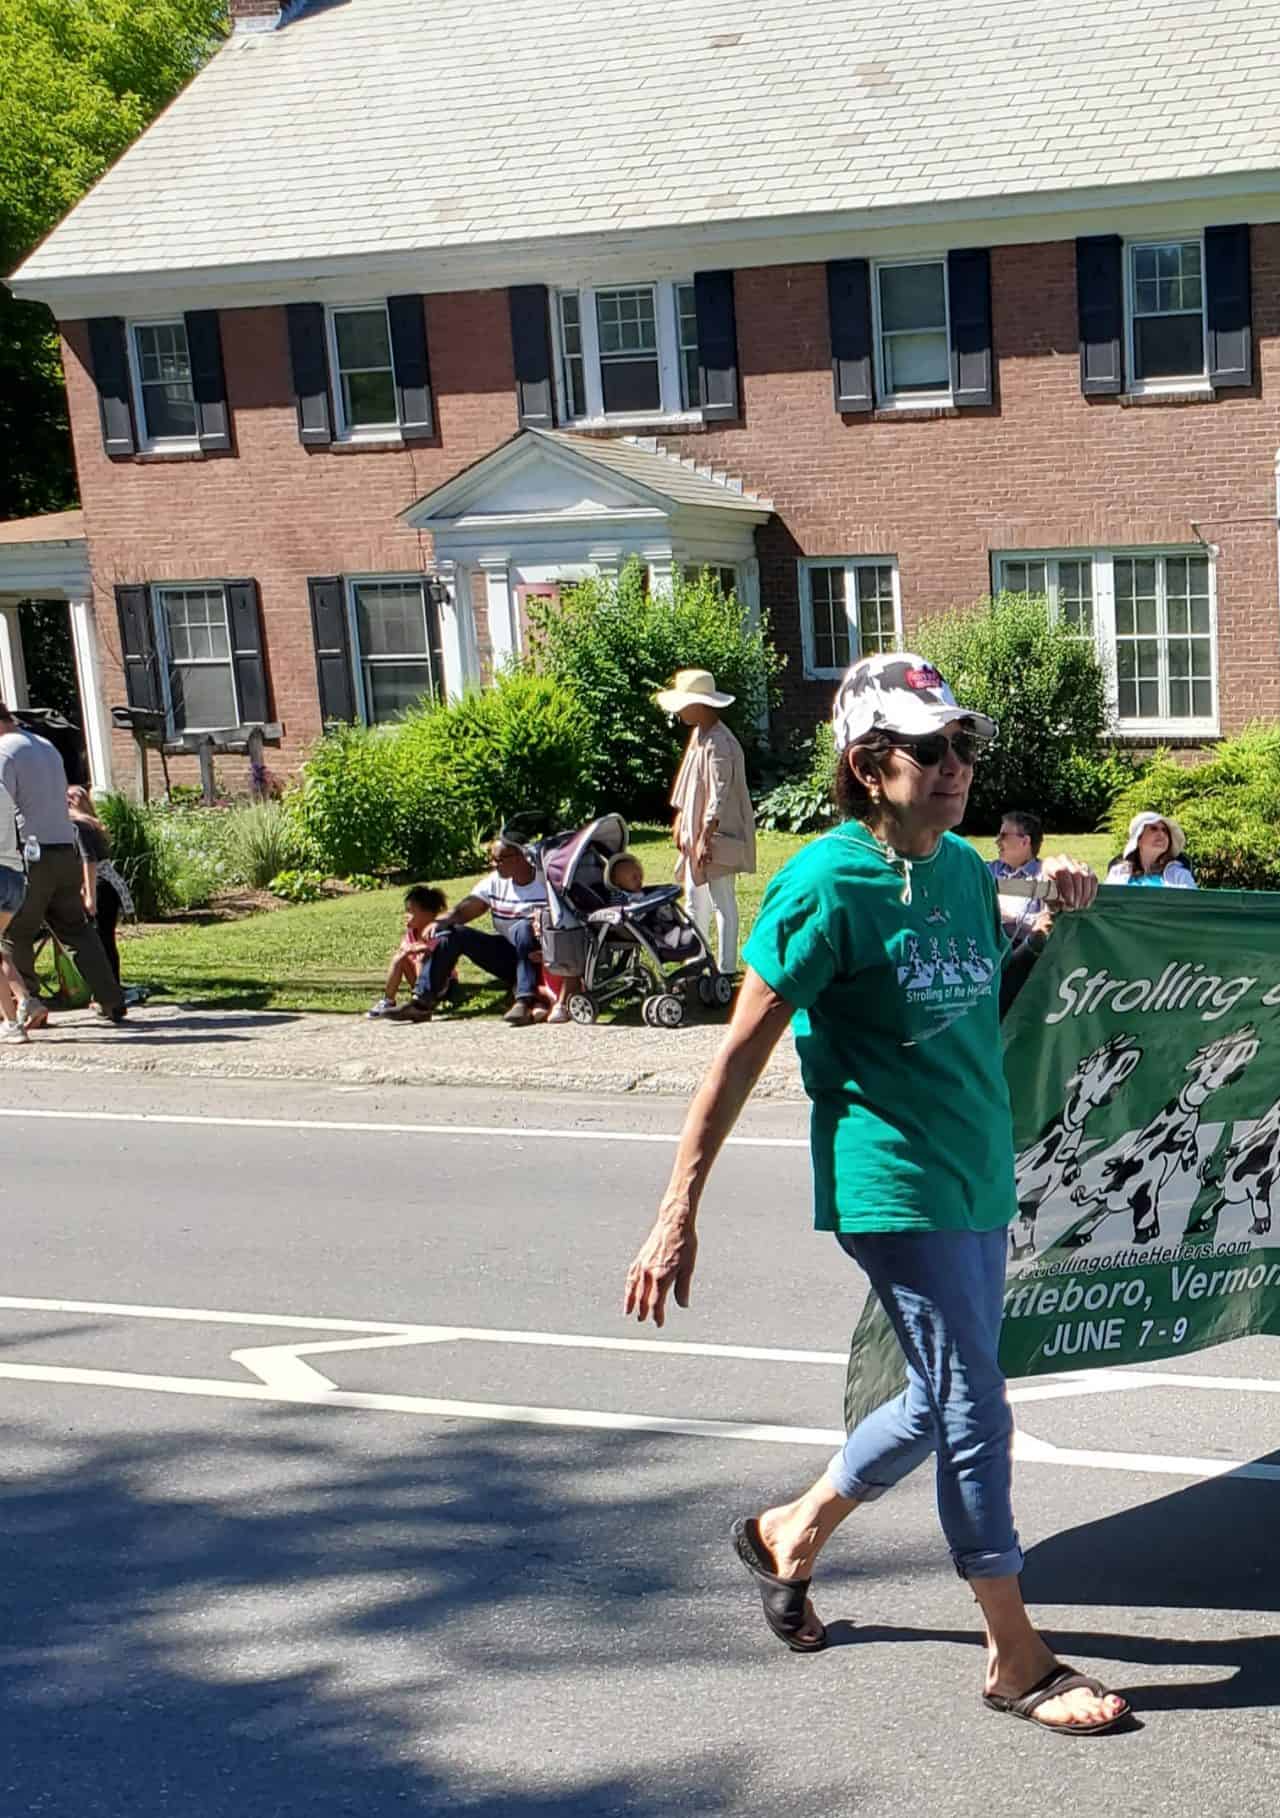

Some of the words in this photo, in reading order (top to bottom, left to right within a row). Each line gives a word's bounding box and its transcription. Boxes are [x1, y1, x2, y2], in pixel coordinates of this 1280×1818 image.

[906, 989, 943, 1003] Strolling
[1046, 962, 1258, 1025] Strolling
[1043, 1317, 1127, 1357] JUNE
